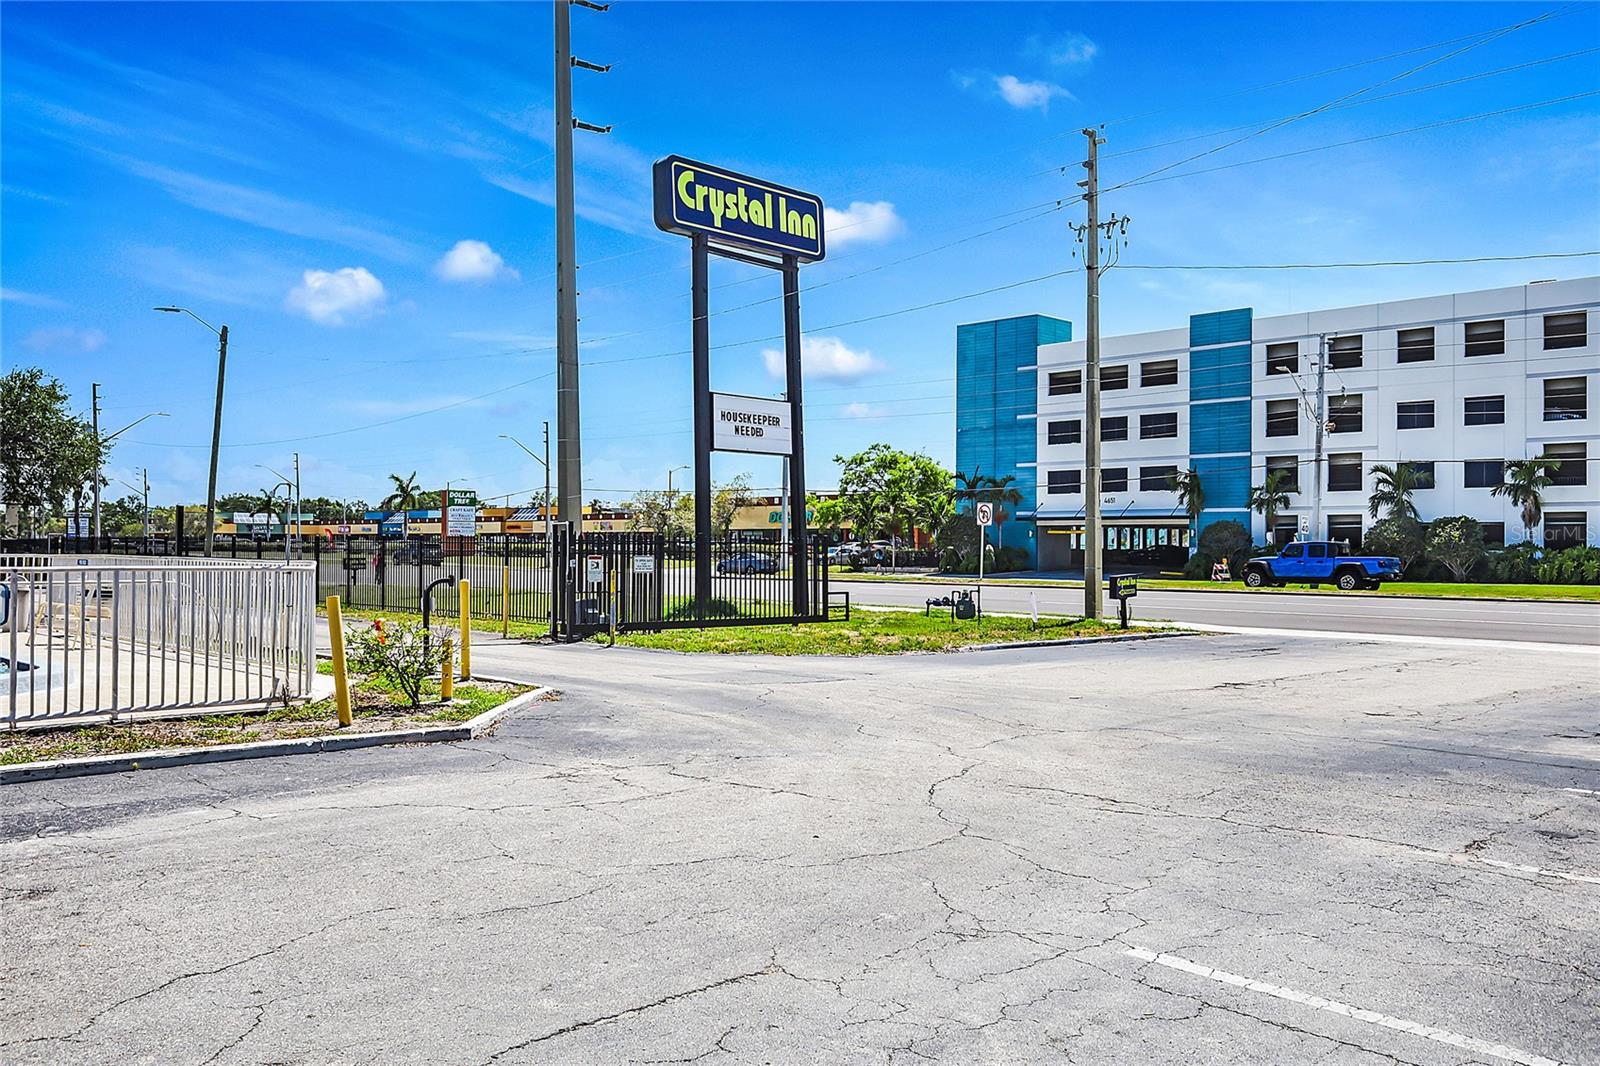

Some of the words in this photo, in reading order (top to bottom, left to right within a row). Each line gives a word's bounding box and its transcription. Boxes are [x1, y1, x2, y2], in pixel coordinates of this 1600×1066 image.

[677, 170, 774, 229] Crystal
[778, 196, 817, 240] Inn
[720, 410, 781, 426] HOUSEKEEPEER
[734, 425, 764, 437] NEEDED
[449, 491, 475, 499] DOLLAR
